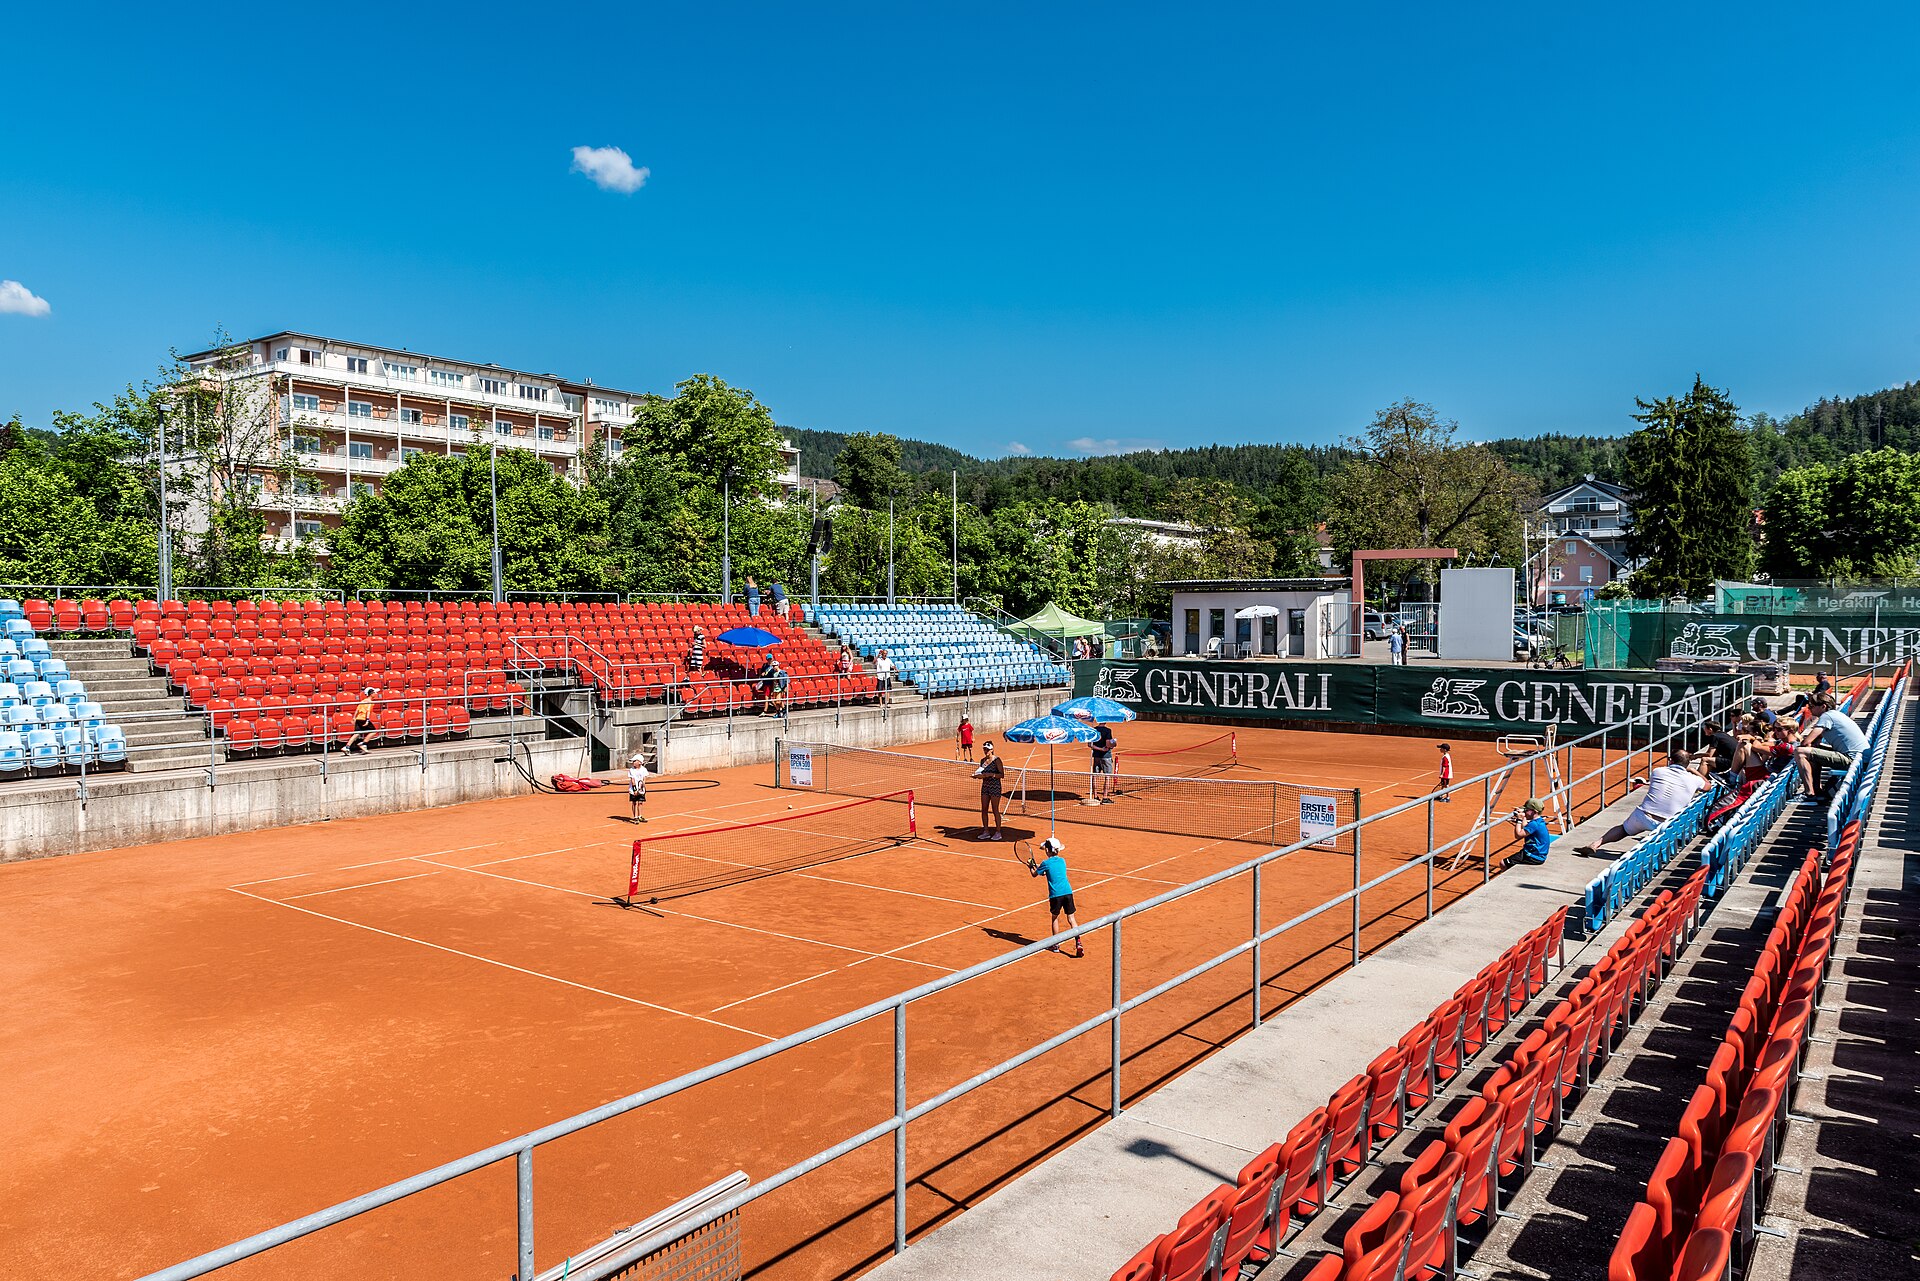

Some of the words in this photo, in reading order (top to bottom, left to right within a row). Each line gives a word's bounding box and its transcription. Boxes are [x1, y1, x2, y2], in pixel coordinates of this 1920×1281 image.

[1817, 596, 1889, 608] Heraklih
[1144, 668, 1333, 711] GENERALI
[1301, 803, 1327, 812] ERSTE
[1301, 811, 1320, 821] OPEN
[1321, 813, 1335, 822] 500
